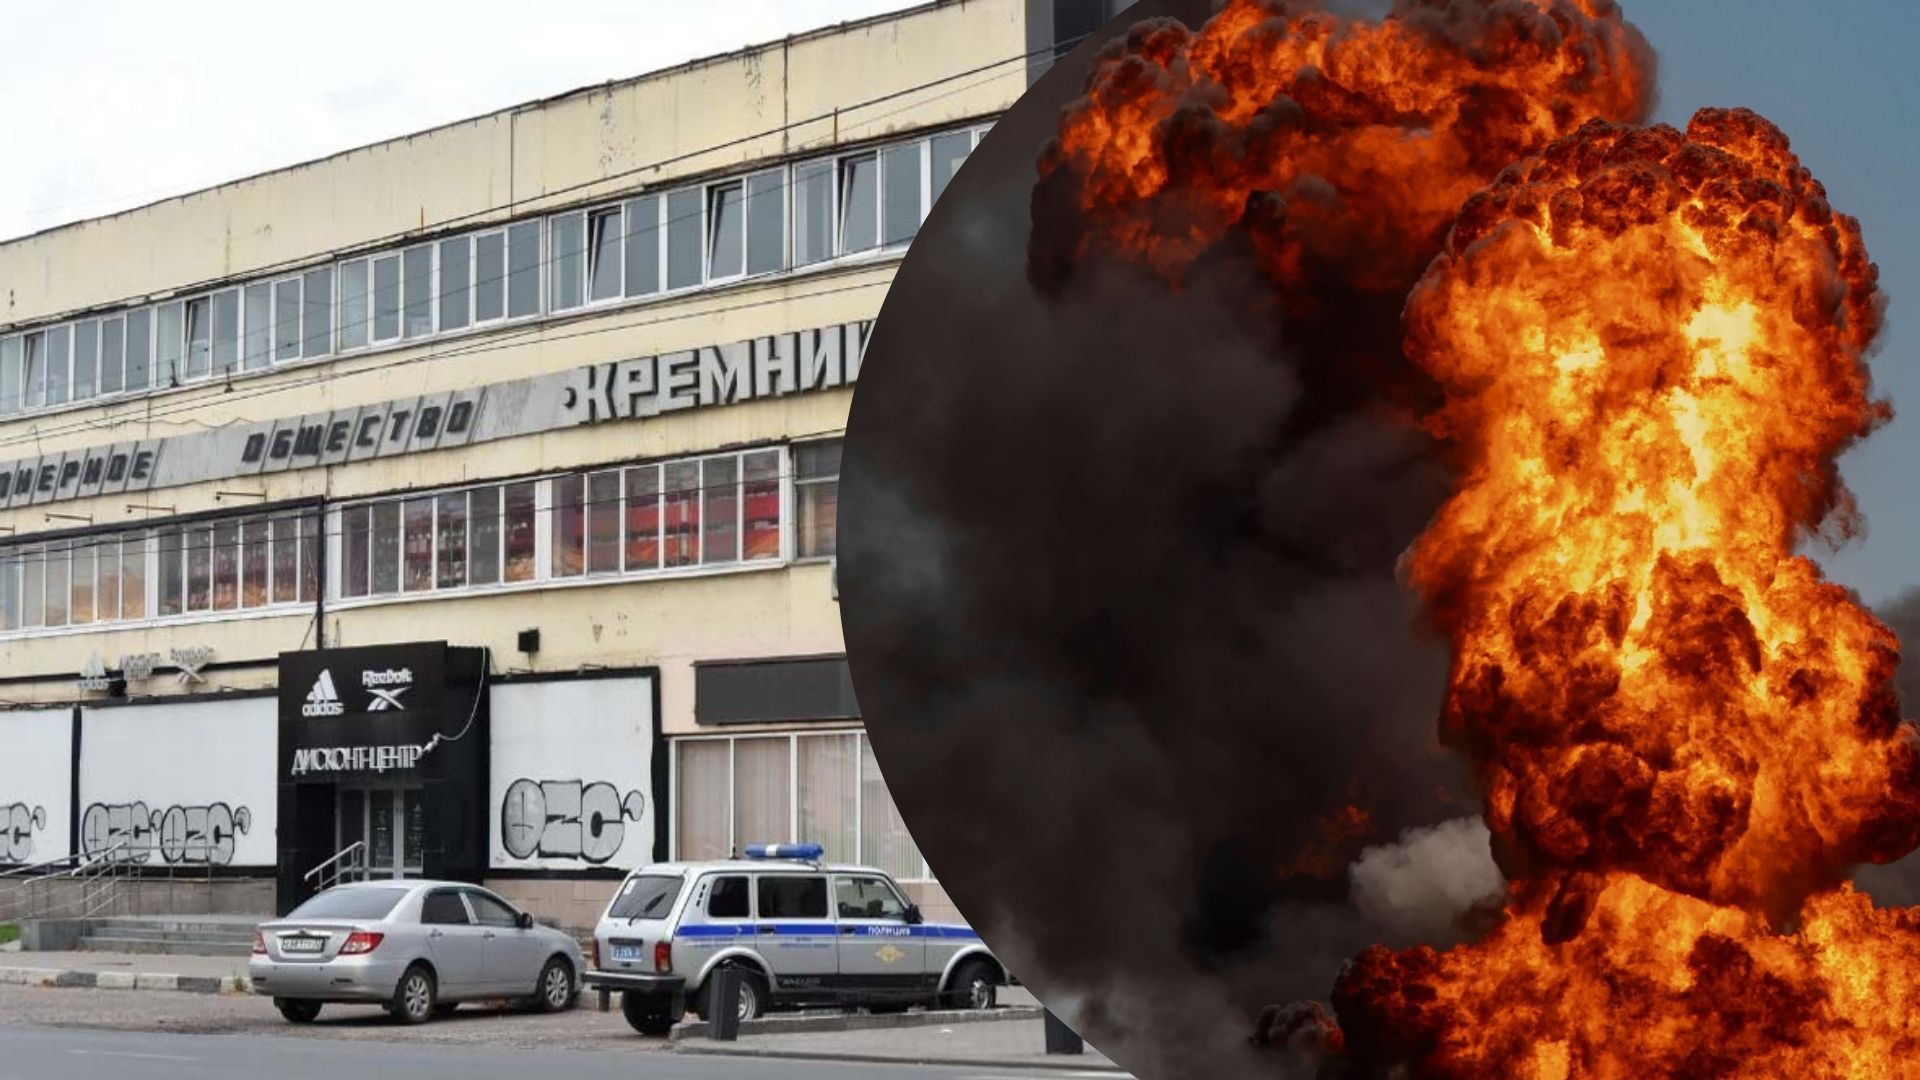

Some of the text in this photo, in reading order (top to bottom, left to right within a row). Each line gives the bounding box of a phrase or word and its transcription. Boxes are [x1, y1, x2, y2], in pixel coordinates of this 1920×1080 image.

[241, 401, 472, 463] ОБЩЕСТВО
[362, 668, 412, 687] Reebok
[302, 701, 344, 717] adidas
